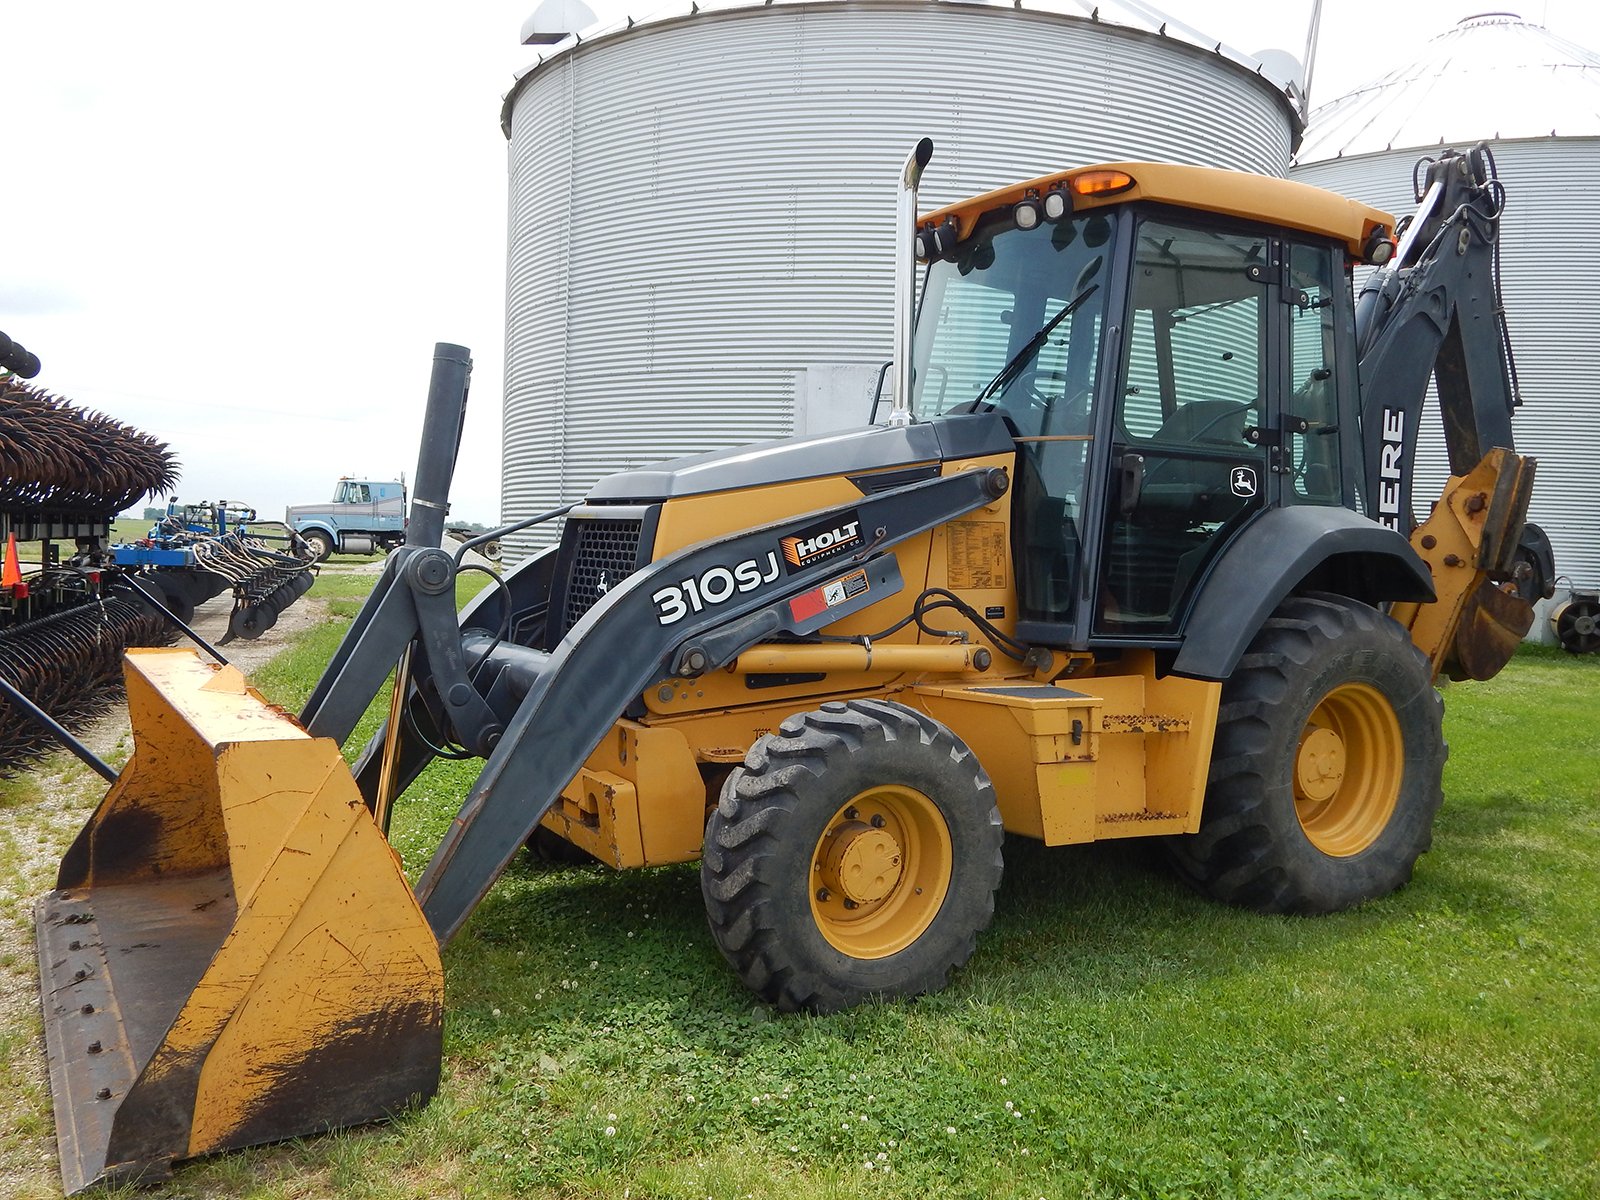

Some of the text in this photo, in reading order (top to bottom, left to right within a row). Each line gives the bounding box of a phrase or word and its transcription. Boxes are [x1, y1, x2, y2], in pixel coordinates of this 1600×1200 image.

[796, 520, 859, 558] HOLT
[801, 544, 846, 566] EQUIPMENT
[652, 551, 780, 625] 310SJ
